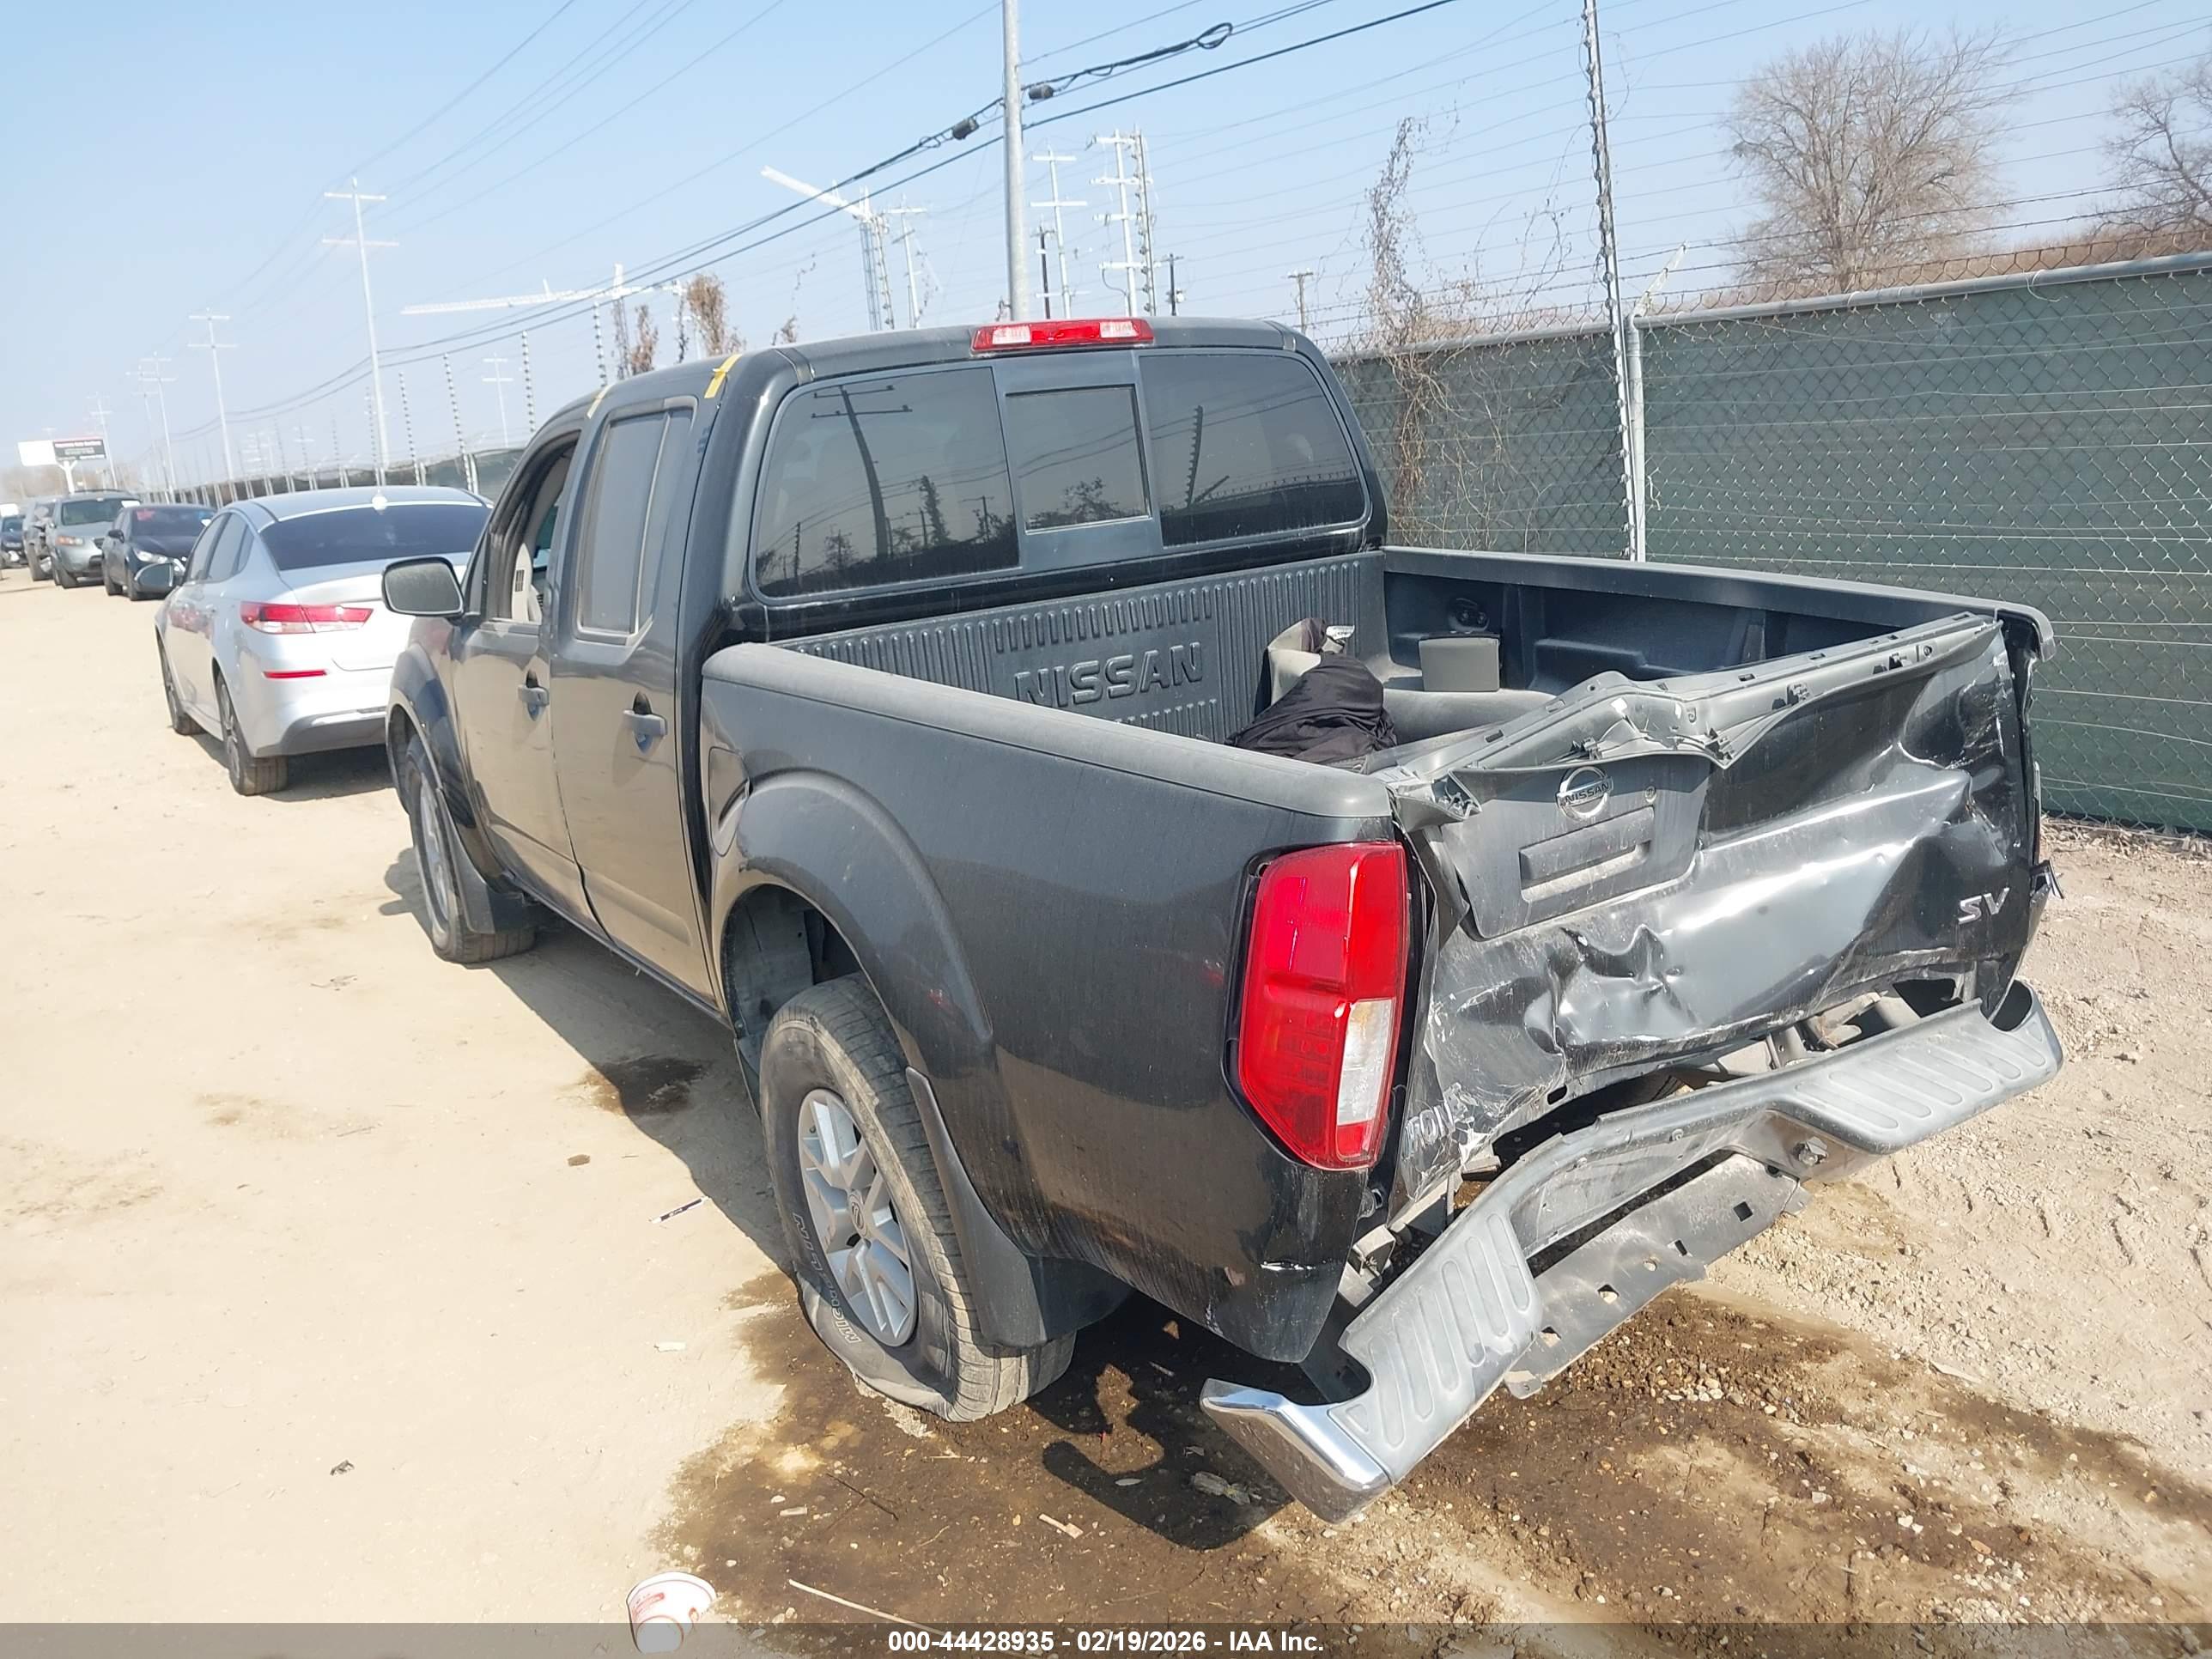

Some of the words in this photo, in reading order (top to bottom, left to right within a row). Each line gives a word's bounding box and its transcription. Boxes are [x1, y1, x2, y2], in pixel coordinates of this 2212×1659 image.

[1013, 641, 1204, 708] NISSAN
[1565, 781, 1610, 804] NISSAN
[1957, 887, 2010, 925] SV
